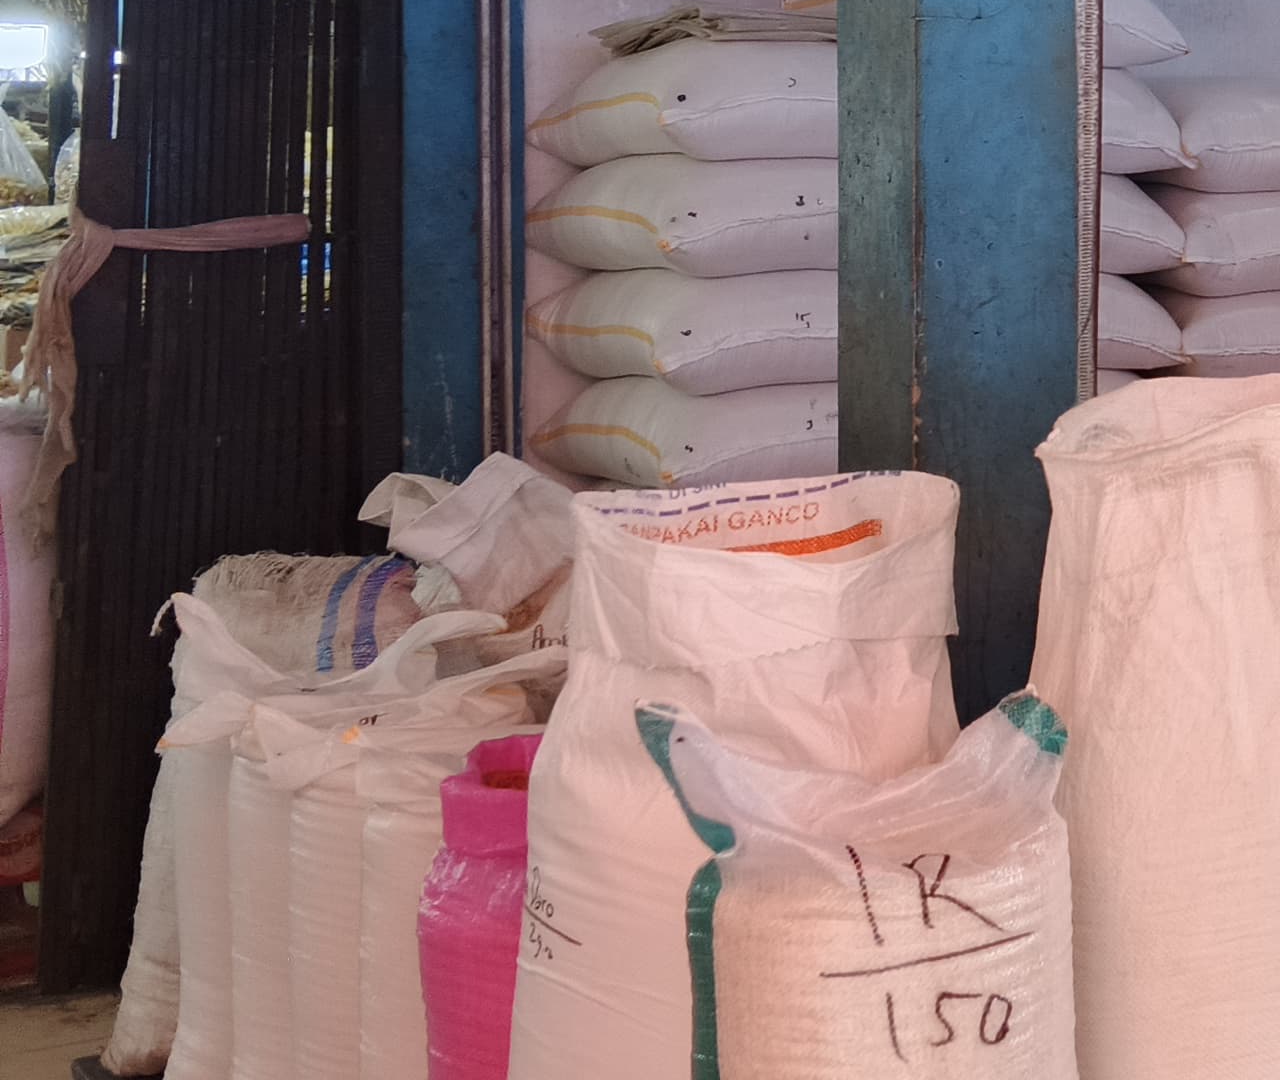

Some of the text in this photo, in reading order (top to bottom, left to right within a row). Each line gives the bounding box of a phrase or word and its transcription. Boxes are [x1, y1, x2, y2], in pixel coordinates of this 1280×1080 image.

[727, 501, 820, 531] GANCO
[845, 844, 1005, 948] IR
[885, 990, 1014, 1064] 150
